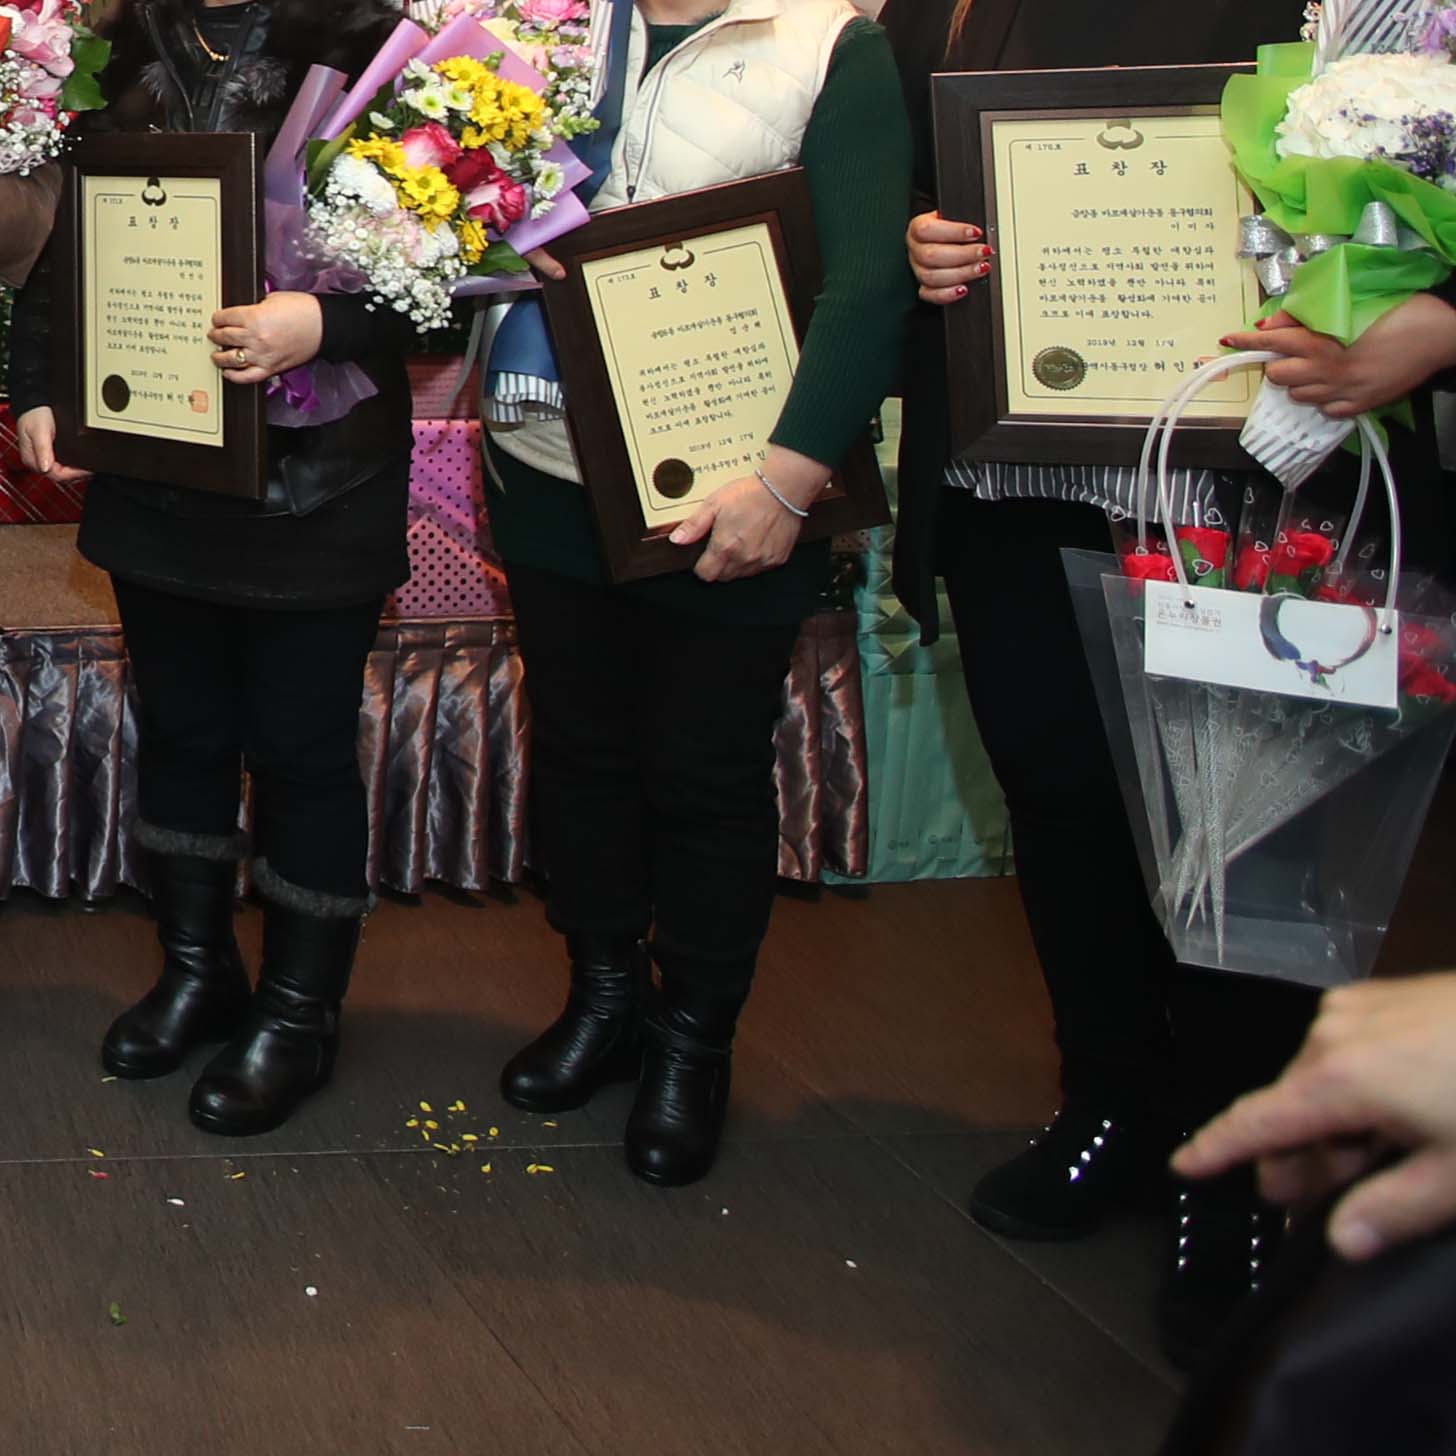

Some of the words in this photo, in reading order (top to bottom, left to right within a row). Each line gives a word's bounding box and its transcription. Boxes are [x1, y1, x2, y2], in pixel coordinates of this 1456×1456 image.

[1073, 162, 1090, 176] 표
[1111, 160, 1128, 176] 창
[1150, 160, 1169, 176] 장
